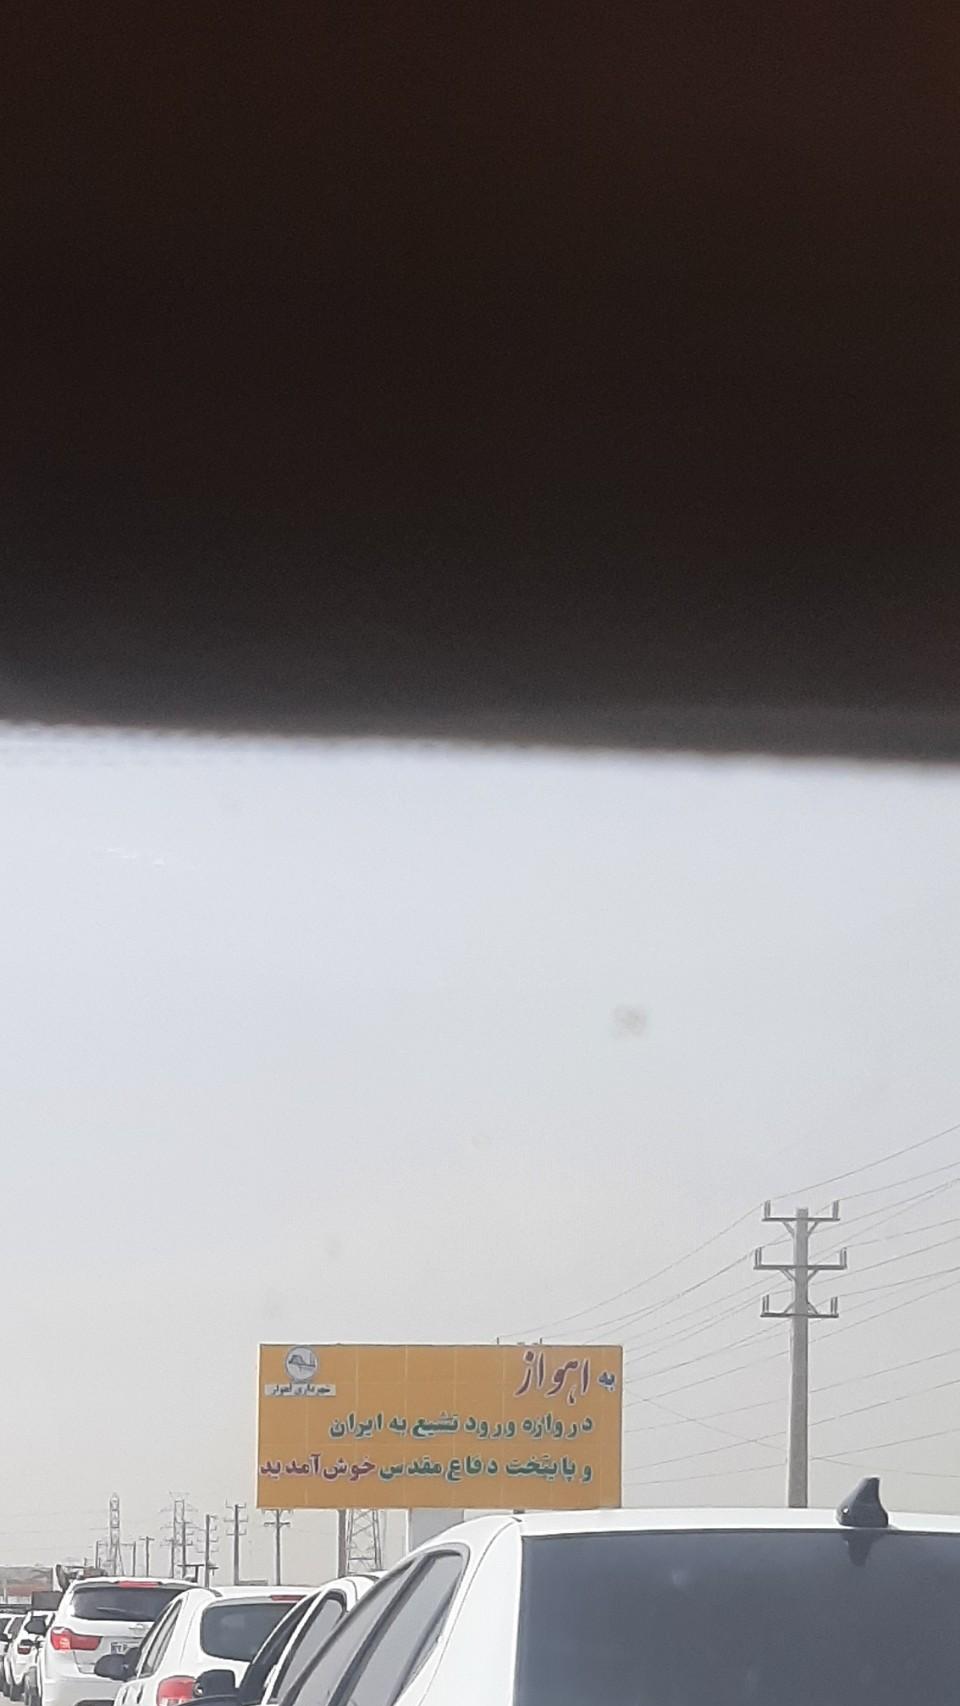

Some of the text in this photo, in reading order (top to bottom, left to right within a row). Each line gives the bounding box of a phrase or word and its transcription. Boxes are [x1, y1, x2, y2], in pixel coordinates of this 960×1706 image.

[514, 1350, 616, 1404] به اهواز
[329, 1410, 594, 1439] دروازه ورود تشیع به ایران
[259, 1453, 593, 1482] و پایتخت دفاع مقدس خوش آمدید
